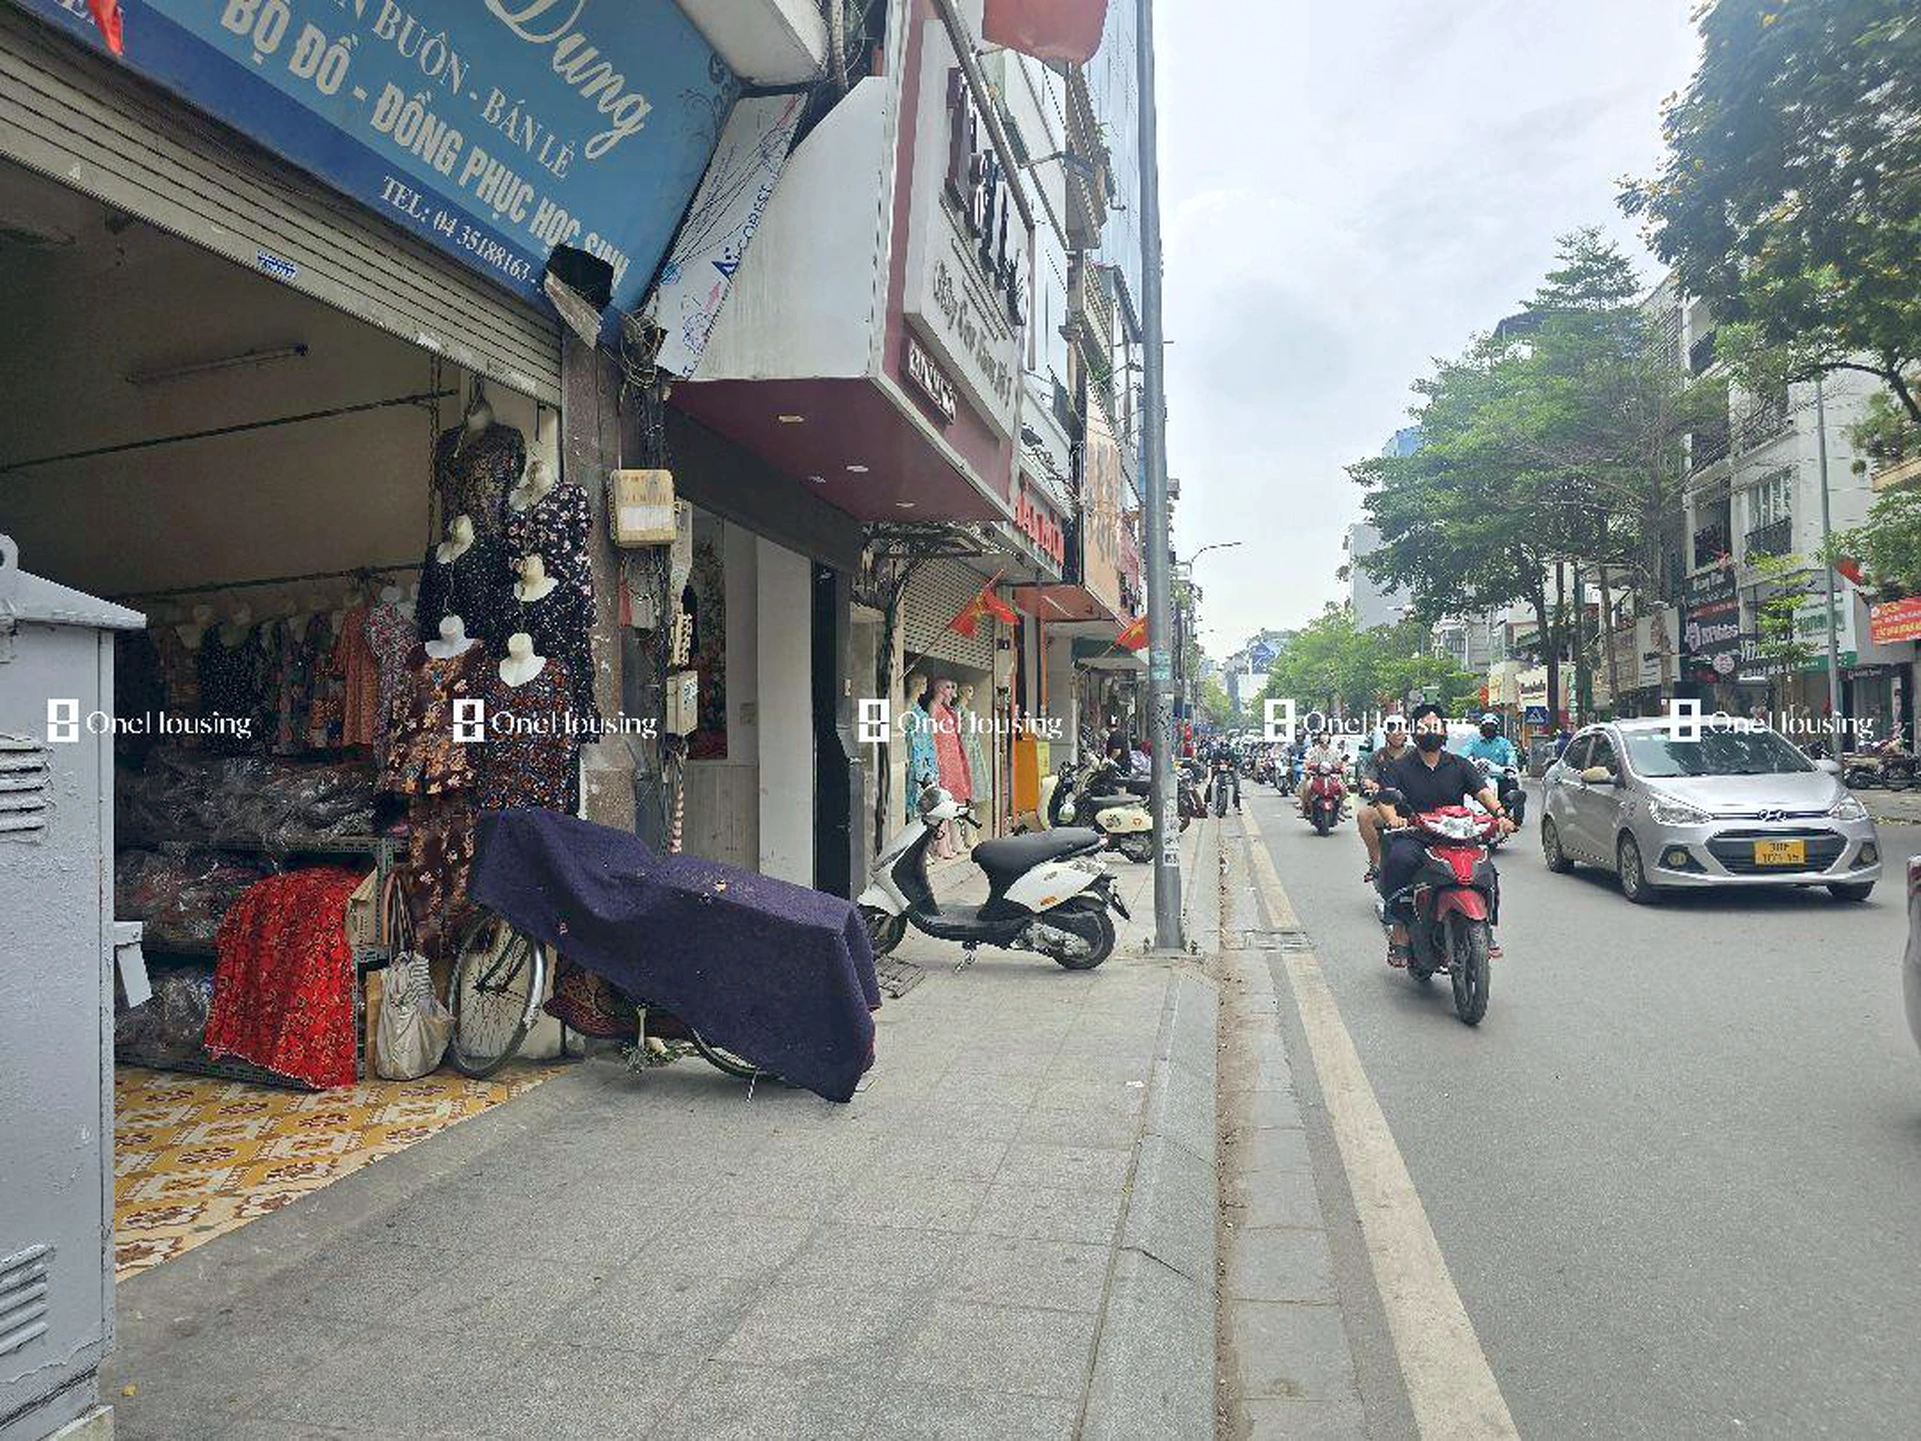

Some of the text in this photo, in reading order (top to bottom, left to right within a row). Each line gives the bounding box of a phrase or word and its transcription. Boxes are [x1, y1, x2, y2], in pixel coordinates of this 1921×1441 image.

[288, 21, 359, 95] ĐỒ
[370, 82, 464, 177] ĐỒNG
[457, 144, 535, 225] PHỤC
[371, 0, 470, 95] BUÔN
[481, 87, 543, 153] BÁN
[379, 174, 430, 223] TEL:
[432, 209, 458, 238] 04
